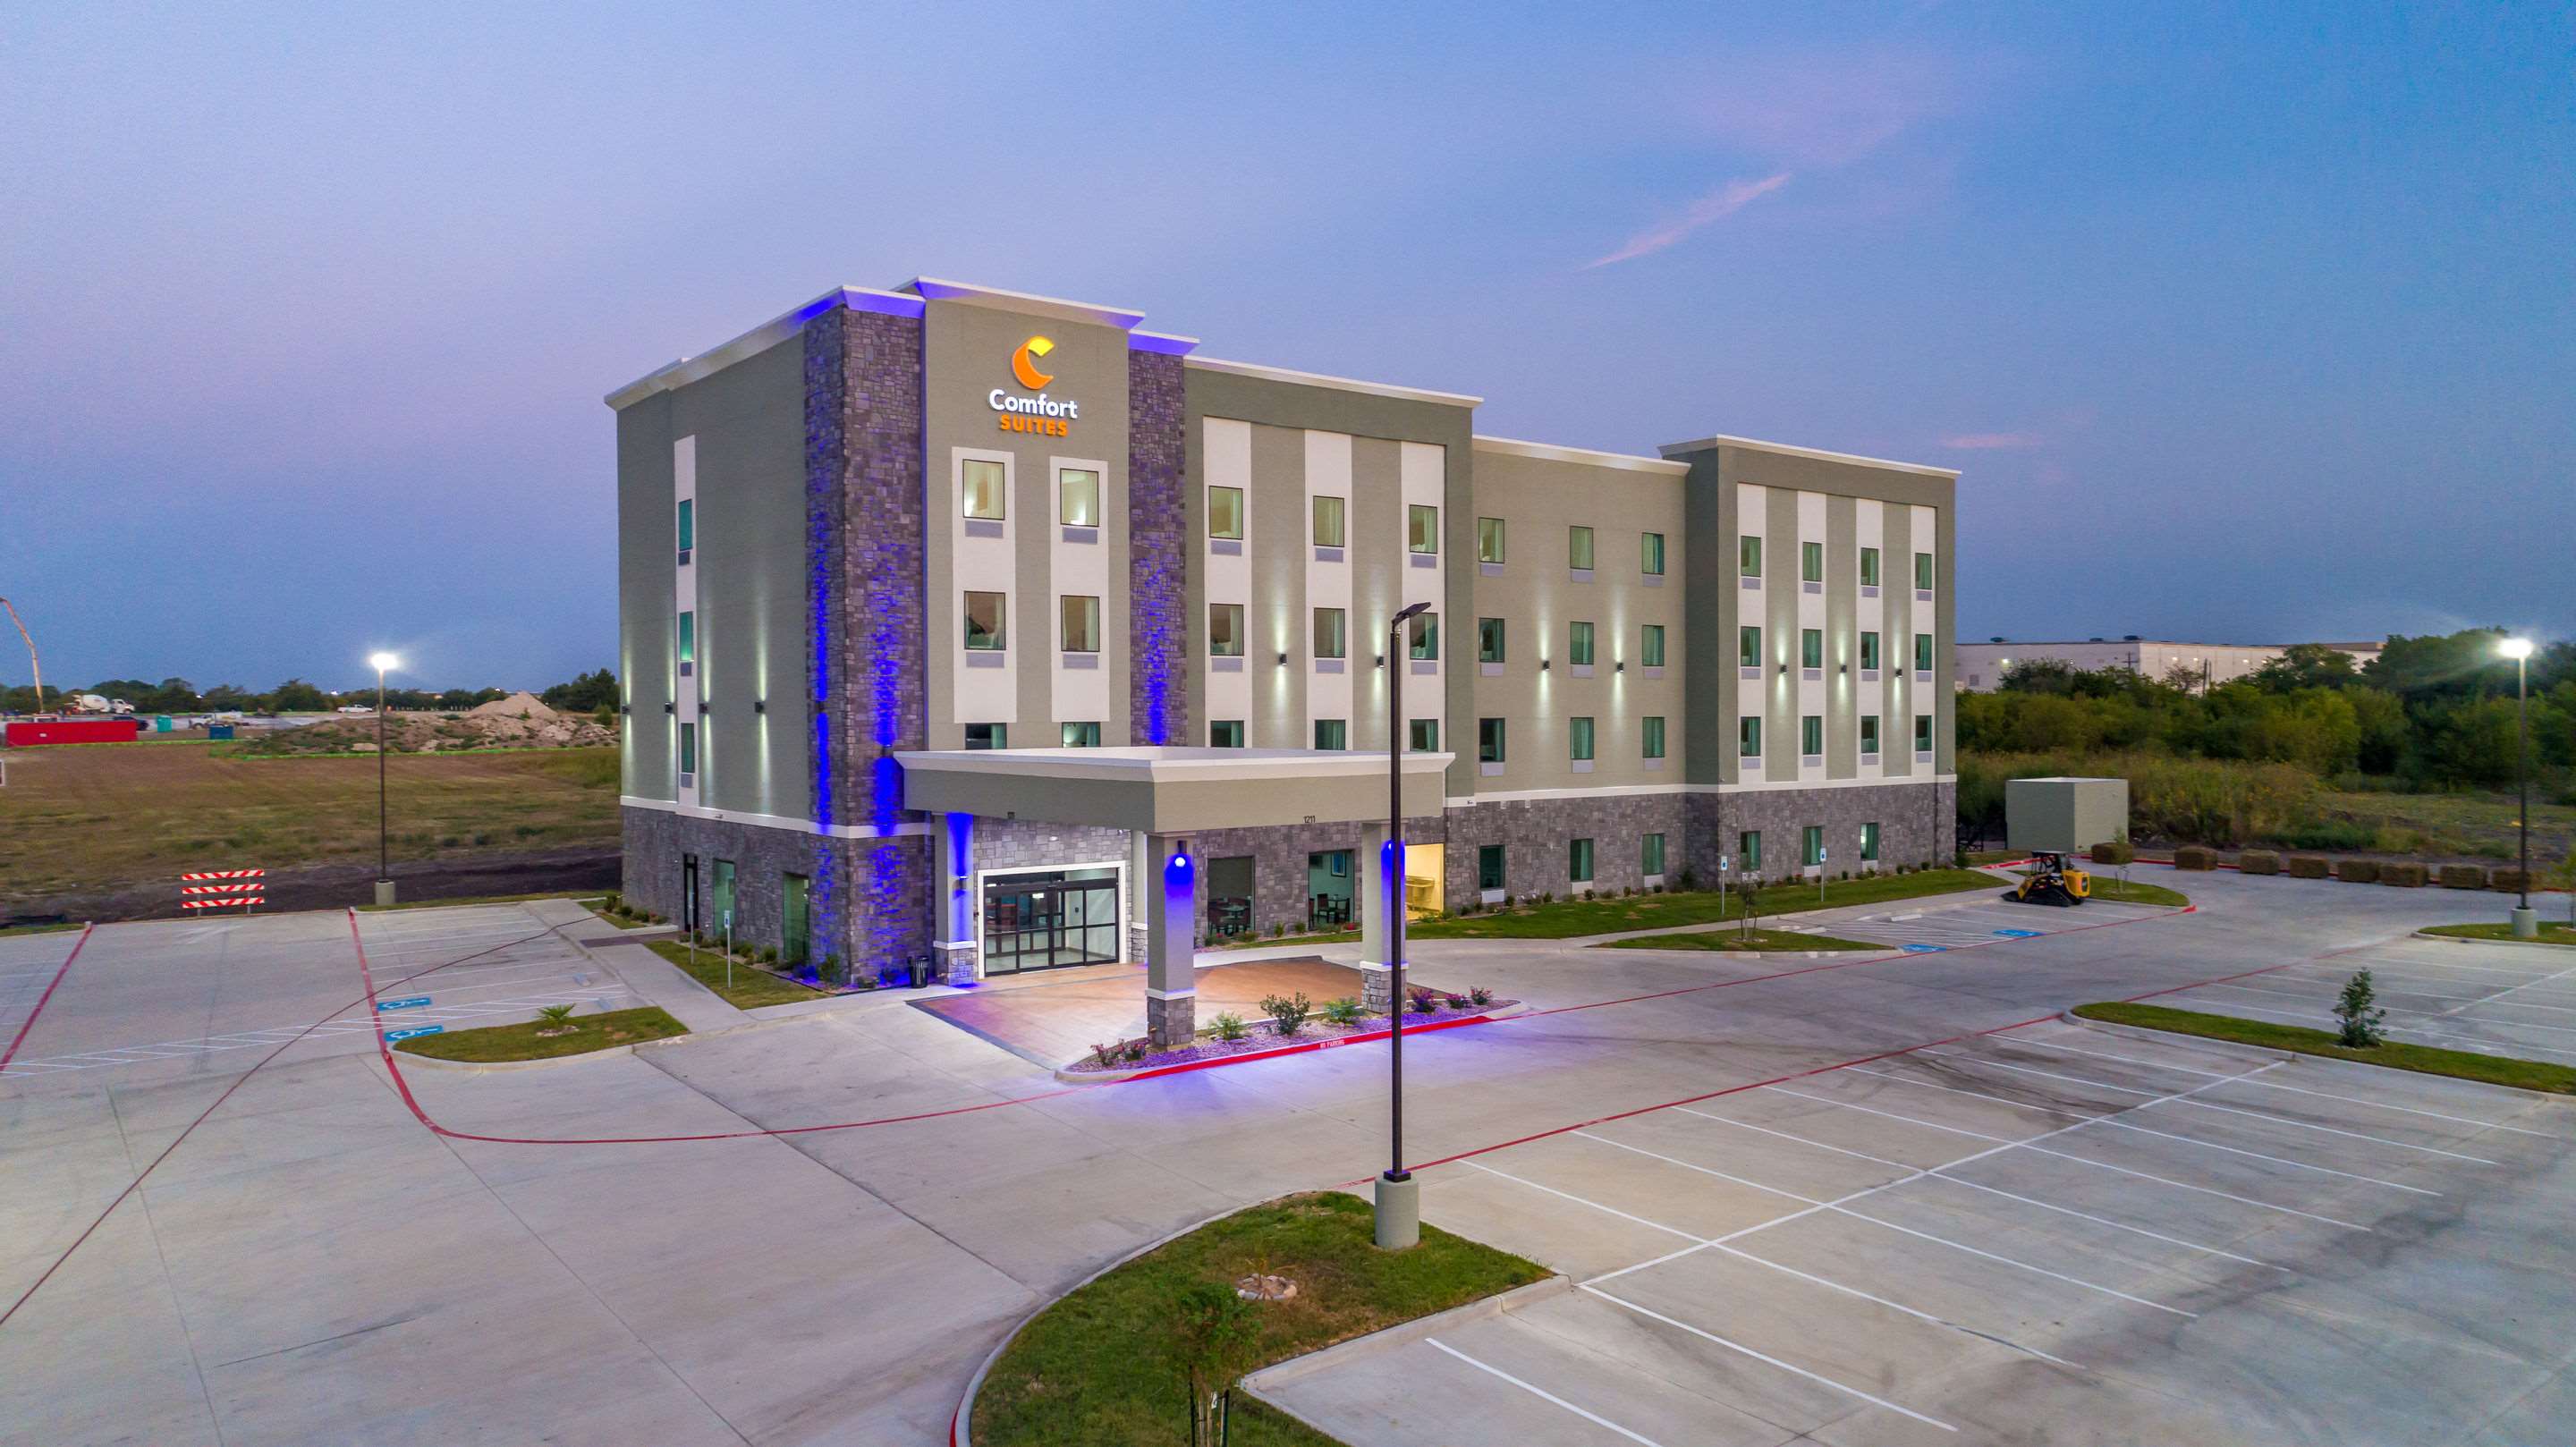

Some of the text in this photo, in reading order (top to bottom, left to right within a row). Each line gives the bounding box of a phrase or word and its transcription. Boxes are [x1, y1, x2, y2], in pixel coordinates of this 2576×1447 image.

[989, 389, 1078, 419] Comfort
[1000, 414, 1068, 436] SUITES
[1303, 815, 1316, 824] 1211
